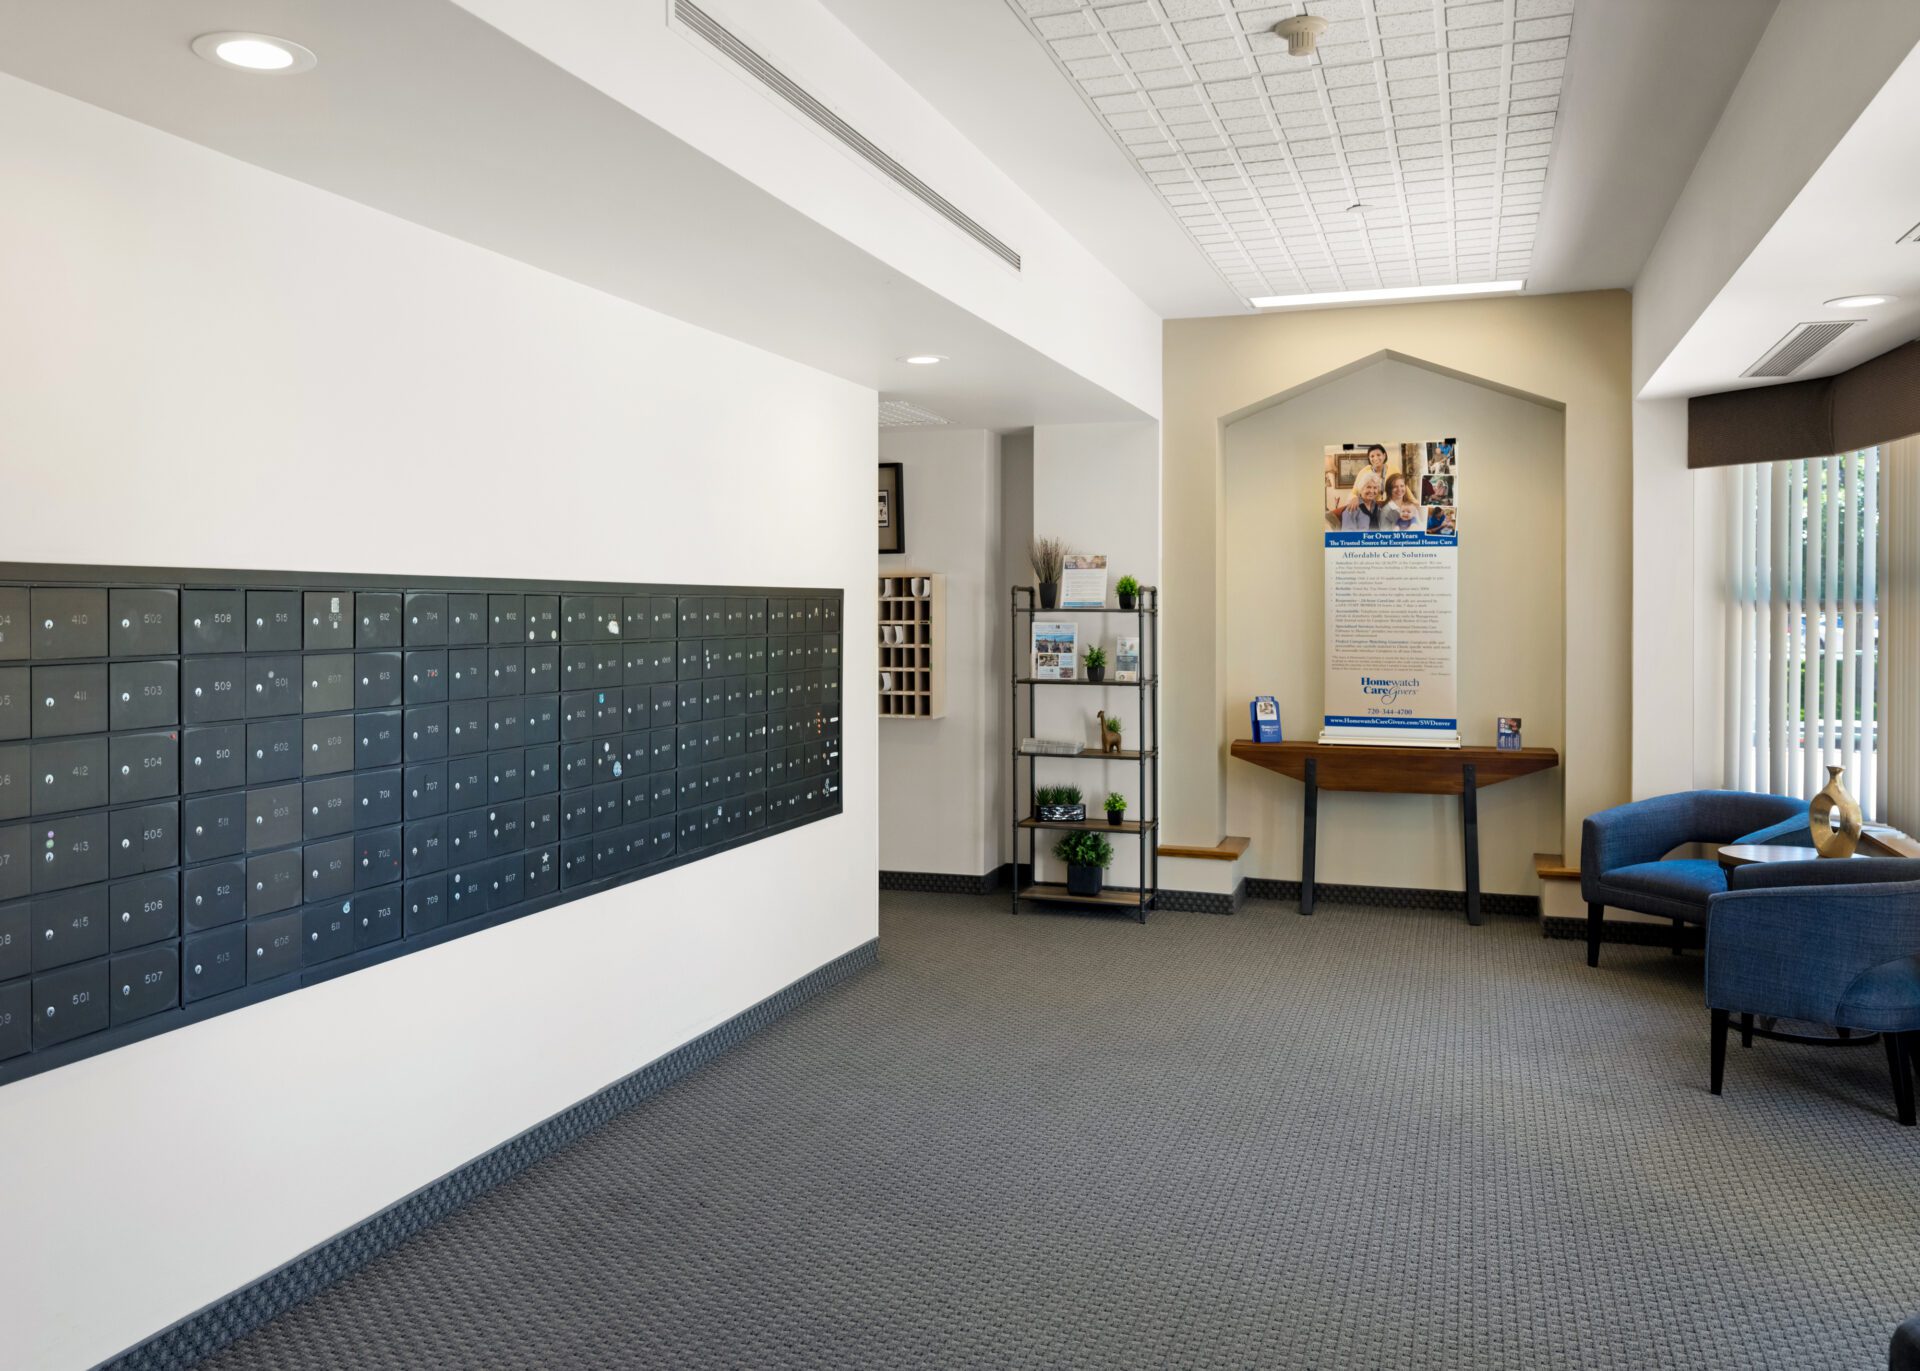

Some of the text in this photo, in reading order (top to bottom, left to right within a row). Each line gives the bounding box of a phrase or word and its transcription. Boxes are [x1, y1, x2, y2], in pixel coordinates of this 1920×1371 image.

[1342, 551, 1380, 559] Affordable
[72, 614, 88, 624] 410
[144, 614, 162, 624] 502
[215, 614, 232, 623] 508
[276, 614, 288, 623] 515
[379, 613, 390, 621] 612
[427, 612, 438, 620] 704
[380, 672, 390, 680] 613
[215, 681, 232, 691] 509
[1361, 677, 1420, 687] Homewatch
[74, 691, 87, 700] 411
[144, 686, 163, 696] 503
[1363, 686, 1417, 705] CareGivers
[427, 725, 439, 733] 706
[379, 731, 390, 740] 615
[274, 743, 289, 752] 602
[216, 750, 230, 759] 510
[144, 757, 162, 768] 504
[72, 766, 89, 776] 412
[469, 776, 478, 784] 713
[427, 782, 437, 791] 707
[380, 790, 390, 799] 701
[328, 799, 342, 808] 609
[218, 818, 229, 826] 511
[506, 822, 516, 830] 806
[144, 829, 163, 840] 505
[469, 830, 477, 839] 715
[73, 841, 89, 852] 413
[427, 838, 438, 847] 708
[330, 861, 342, 870] 610
[217, 886, 230, 896] 512
[469, 884, 478, 893] 801
[427, 895, 438, 905] 709
[144, 901, 163, 912] 506
[378, 908, 391, 918] 703
[73, 917, 89, 928] 415
[217, 953, 230, 964] 513
[145, 971, 163, 984] 507
[73, 992, 90, 1005] 501
